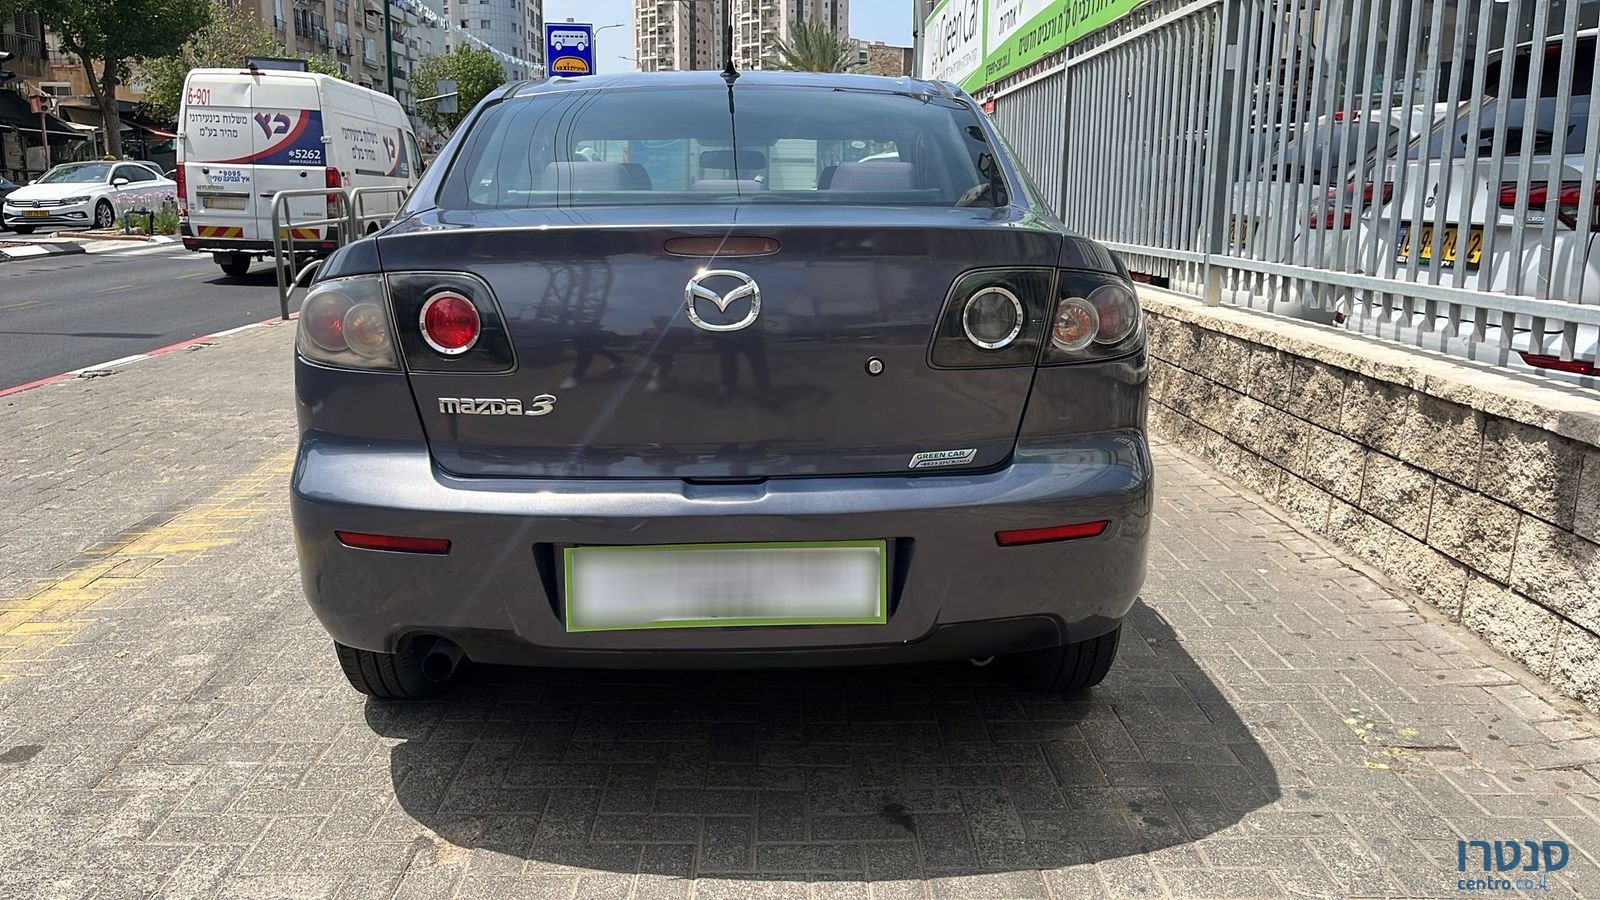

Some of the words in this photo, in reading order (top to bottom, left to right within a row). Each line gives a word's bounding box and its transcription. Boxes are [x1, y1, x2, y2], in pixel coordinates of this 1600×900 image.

[187, 88, 210, 106] 6-901
[189, 113, 220, 124] בינעירוני
[222, 113, 248, 125] משלוח
[219, 128, 239, 138] מהיר
[524, 393, 557, 417] 3
[916, 452, 946, 460] GREEN
